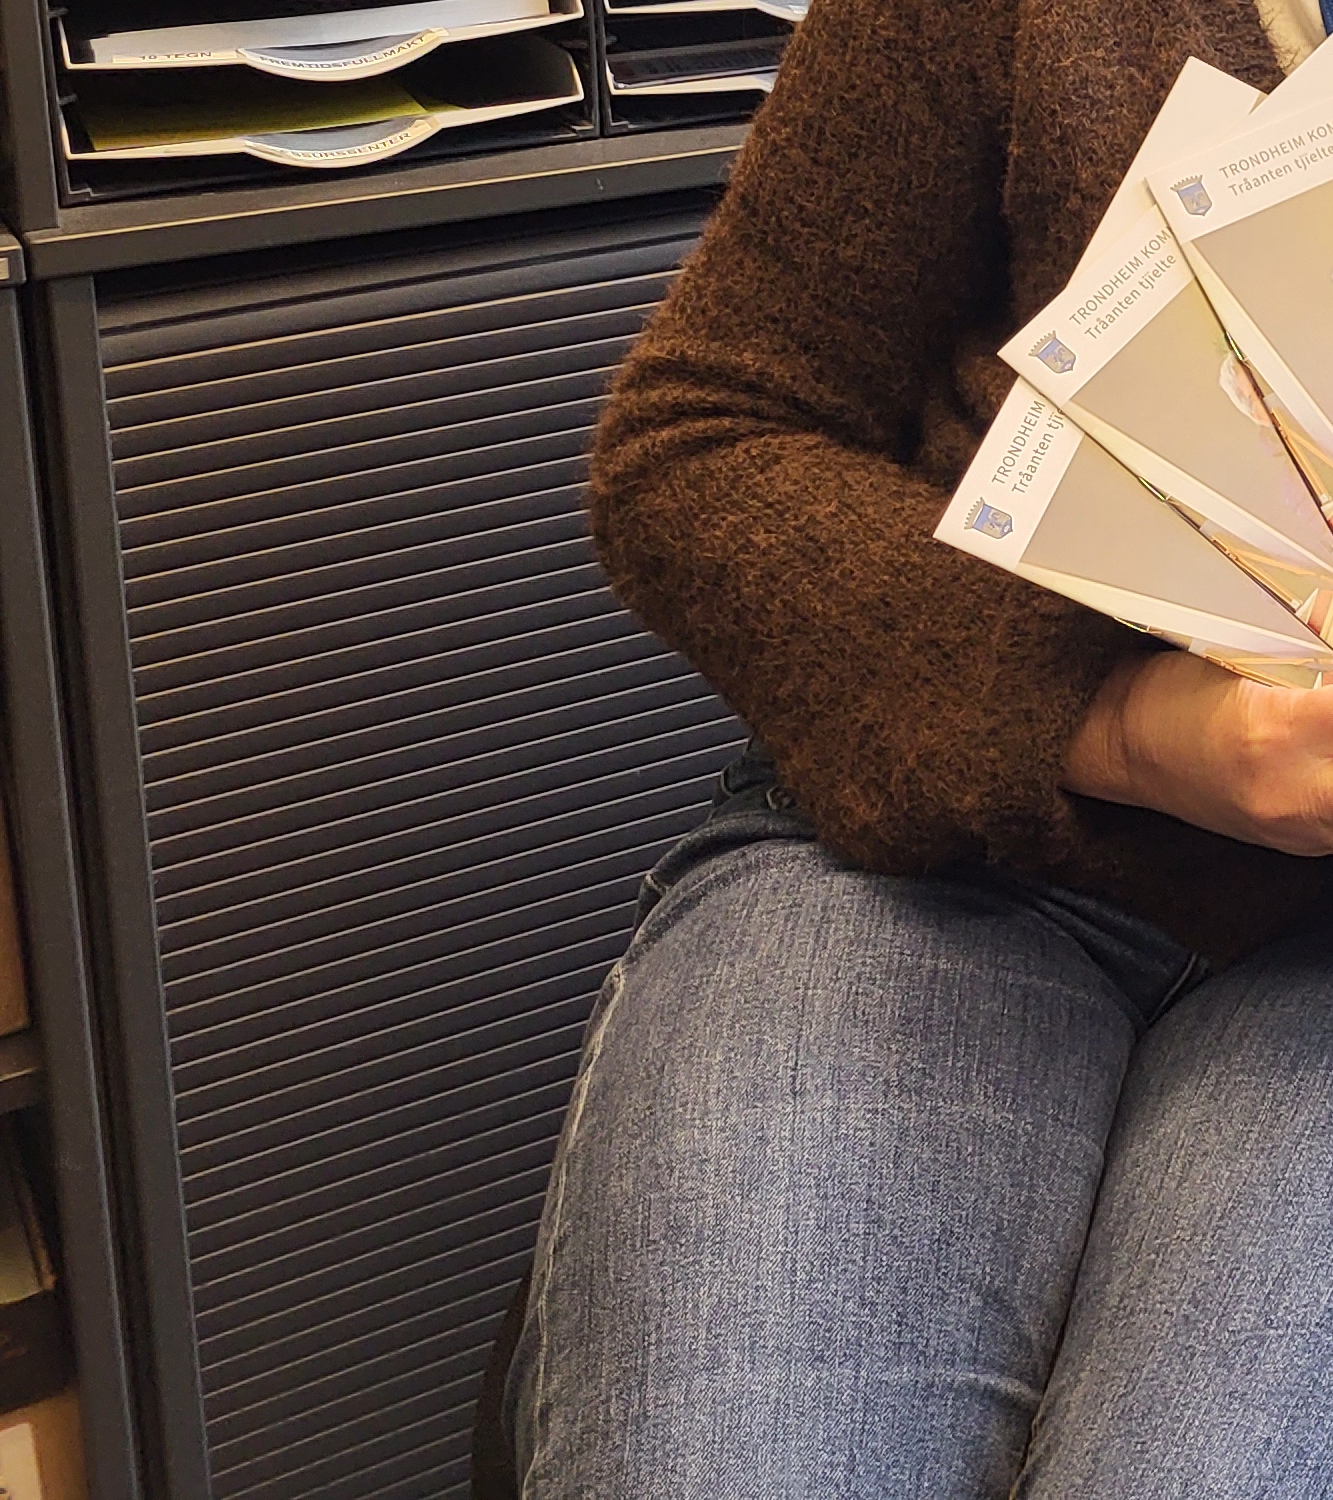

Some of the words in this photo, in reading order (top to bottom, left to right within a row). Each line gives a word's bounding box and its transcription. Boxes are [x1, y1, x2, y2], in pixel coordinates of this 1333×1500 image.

[259, 35, 426, 69] FREMTIDSFULLMAKT
[1218, 135, 1306, 179] TRONDHEIM
[1228, 160, 1293, 197] Tråanten
[1069, 255, 1144, 326] TRONDHEIM
[1084, 288, 1142, 340] Tråanten
[991, 400, 1046, 486] TRONDHEIM
[1011, 431, 1055, 496] Tråanten
